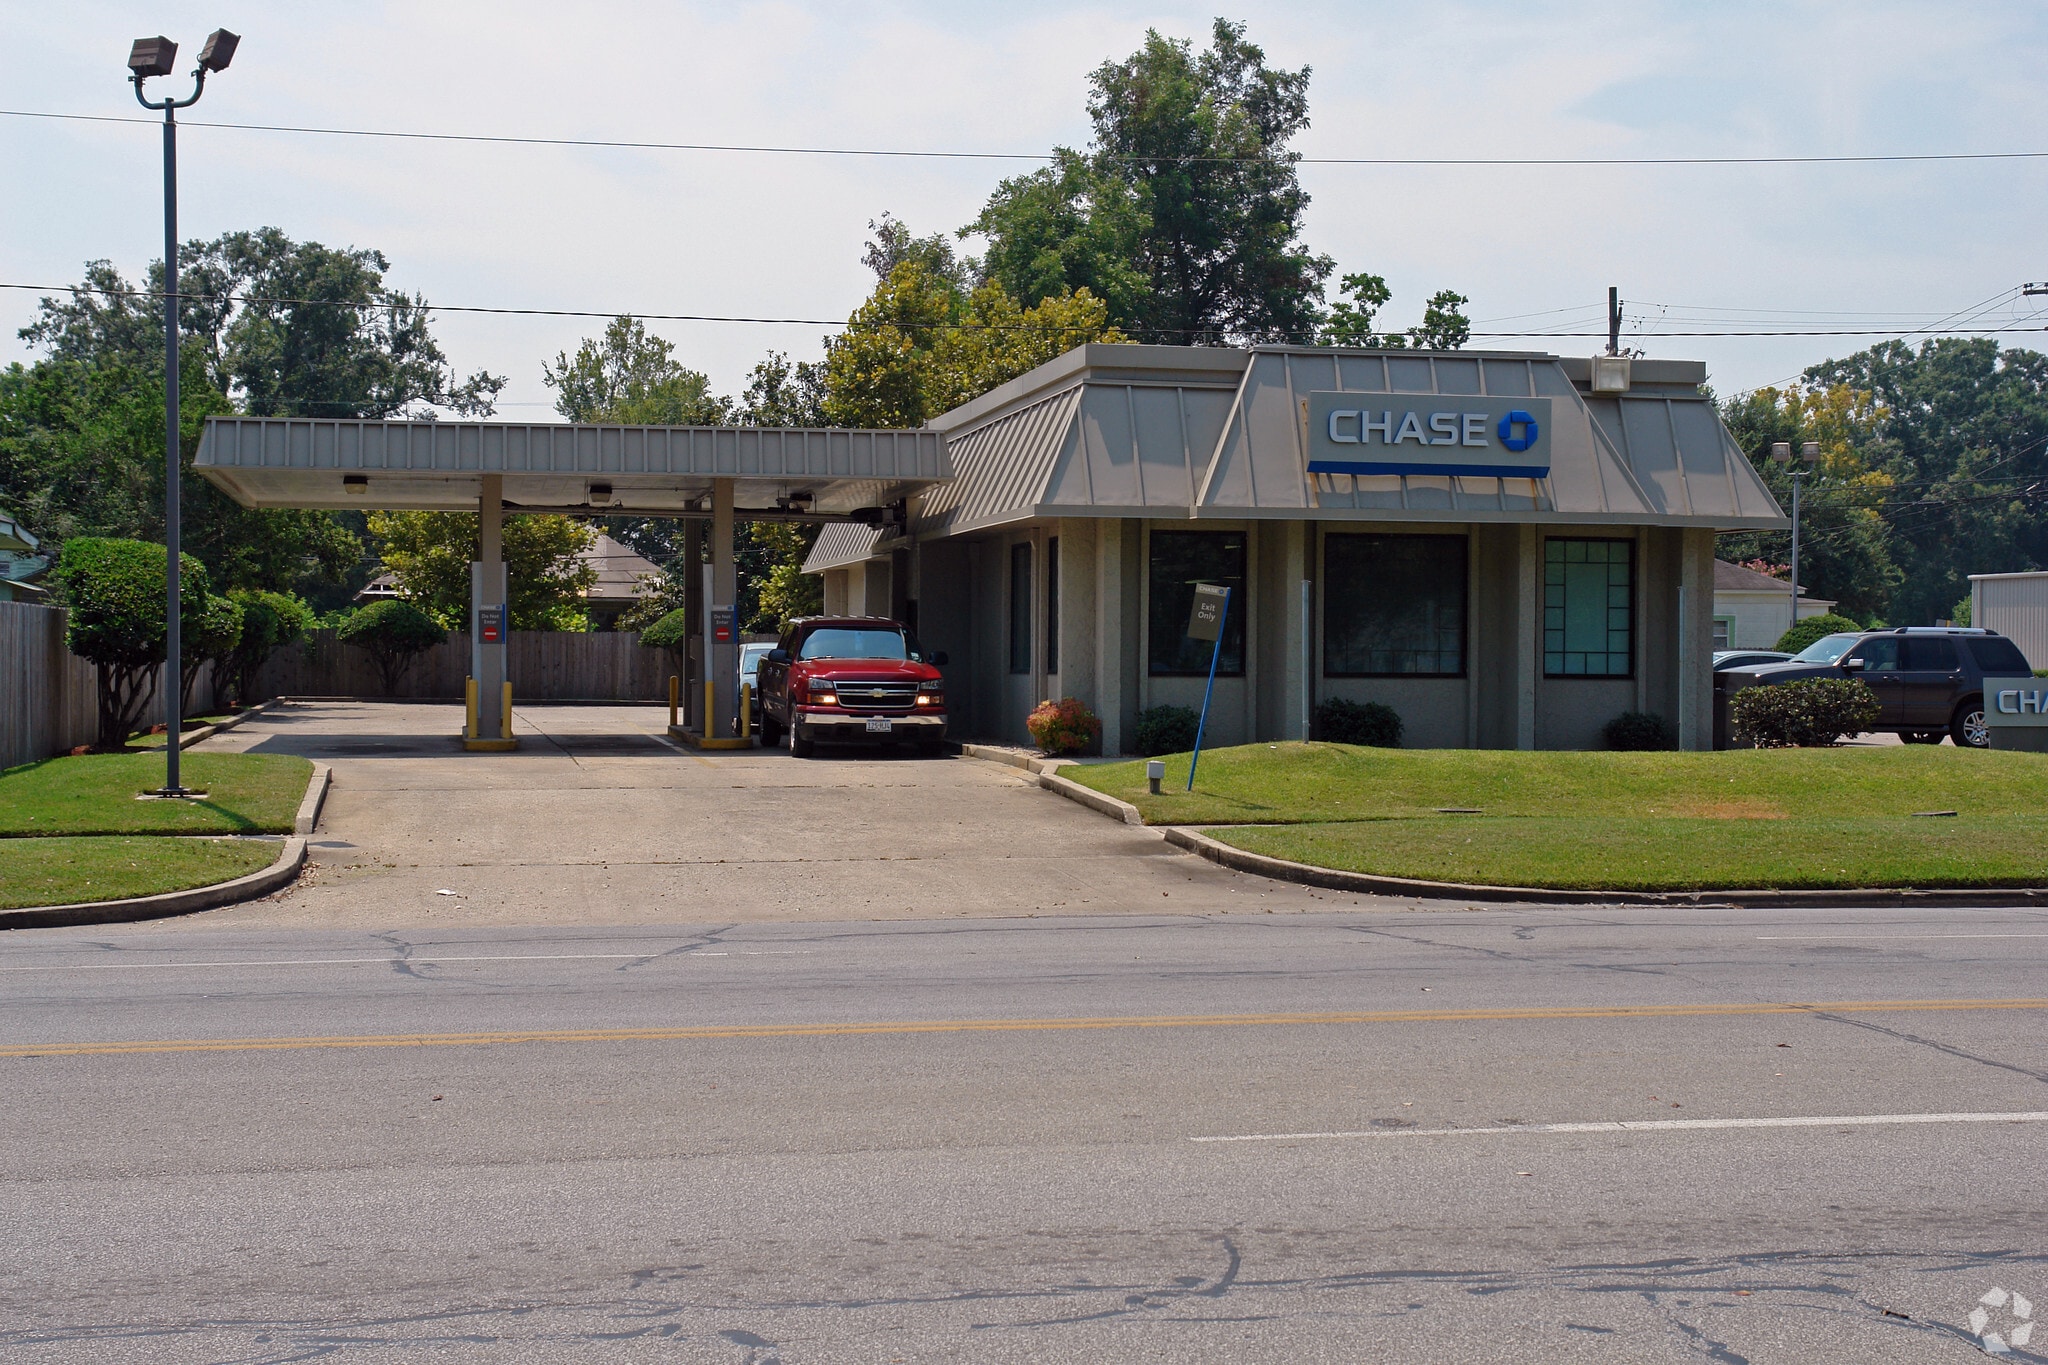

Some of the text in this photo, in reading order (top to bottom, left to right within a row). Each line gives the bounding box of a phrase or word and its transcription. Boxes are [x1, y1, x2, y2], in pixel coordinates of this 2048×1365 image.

[1329, 410, 1489, 446] CHASE
[1199, 585, 1218, 594] CHASE
[1201, 602, 1216, 612] Exit
[1198, 611, 1216, 623] Only
